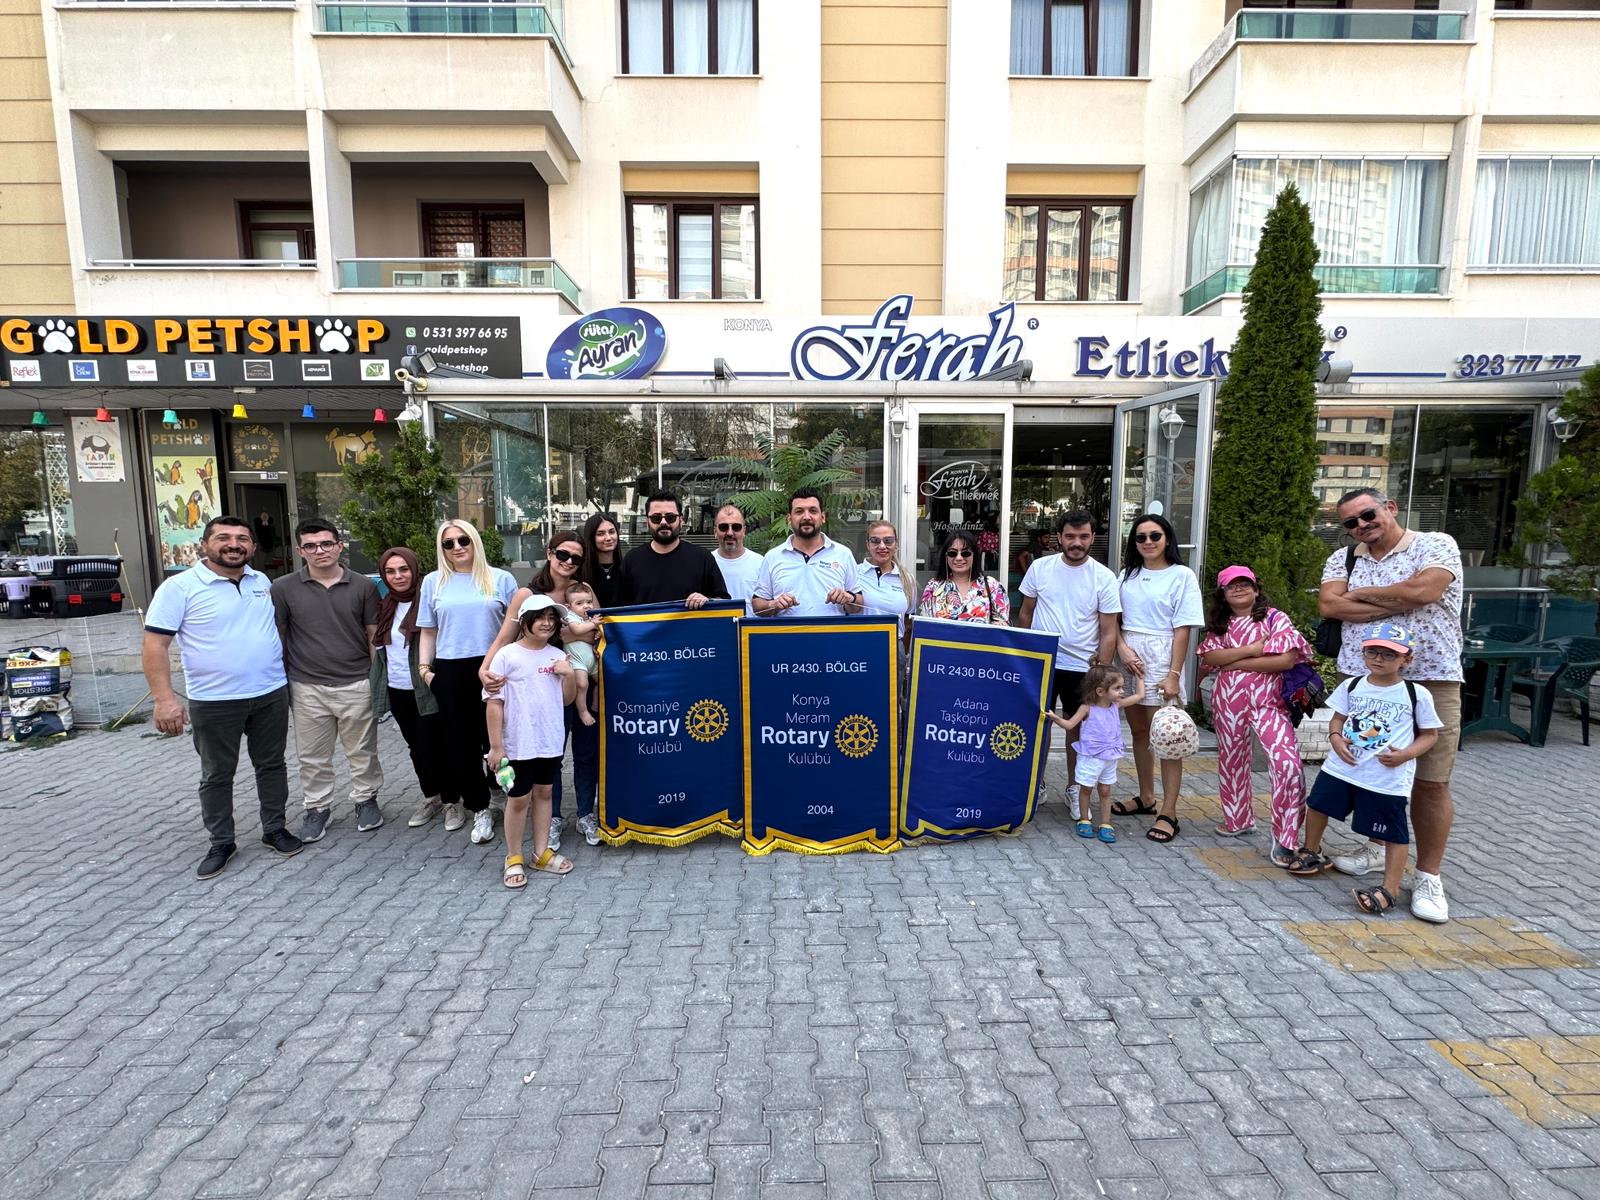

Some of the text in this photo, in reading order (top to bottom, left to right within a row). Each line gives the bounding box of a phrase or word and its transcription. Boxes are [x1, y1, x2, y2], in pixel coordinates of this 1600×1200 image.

[724, 318, 772, 331] KONYA
[423, 327, 508, 339] 0 531 397 66 95
[578, 332, 637, 374] Ayran
[1460, 354, 1505, 377] 323
[1513, 354, 1543, 374] 77
[953, 488, 1000, 501] Etliekmek
[622, 647, 716, 663] UR 2430. BÖLGE
[771, 660, 868, 673] UR 2430. BÖLGE
[928, 664, 1020, 684] UR 2430 BÖLGE
[792, 694, 830, 708] Konya
[953, 698, 989, 711] Adana
[617, 700, 680, 716] Osmaniye
[786, 712, 830, 724] Meram
[940, 709, 988, 725] Taşköprü
[613, 715, 680, 736] Rotary
[761, 726, 830, 748] Rotary
[925, 723, 986, 748] Rotary
[638, 741, 682, 755] Kulübü
[788, 752, 831, 765] Kulübü
[947, 750, 985, 763] Kulübü
[658, 792, 686, 804] 2019
[807, 805, 834, 815] 2004
[956, 807, 982, 819] 2019
[1373, 822, 1387, 834] GAP
